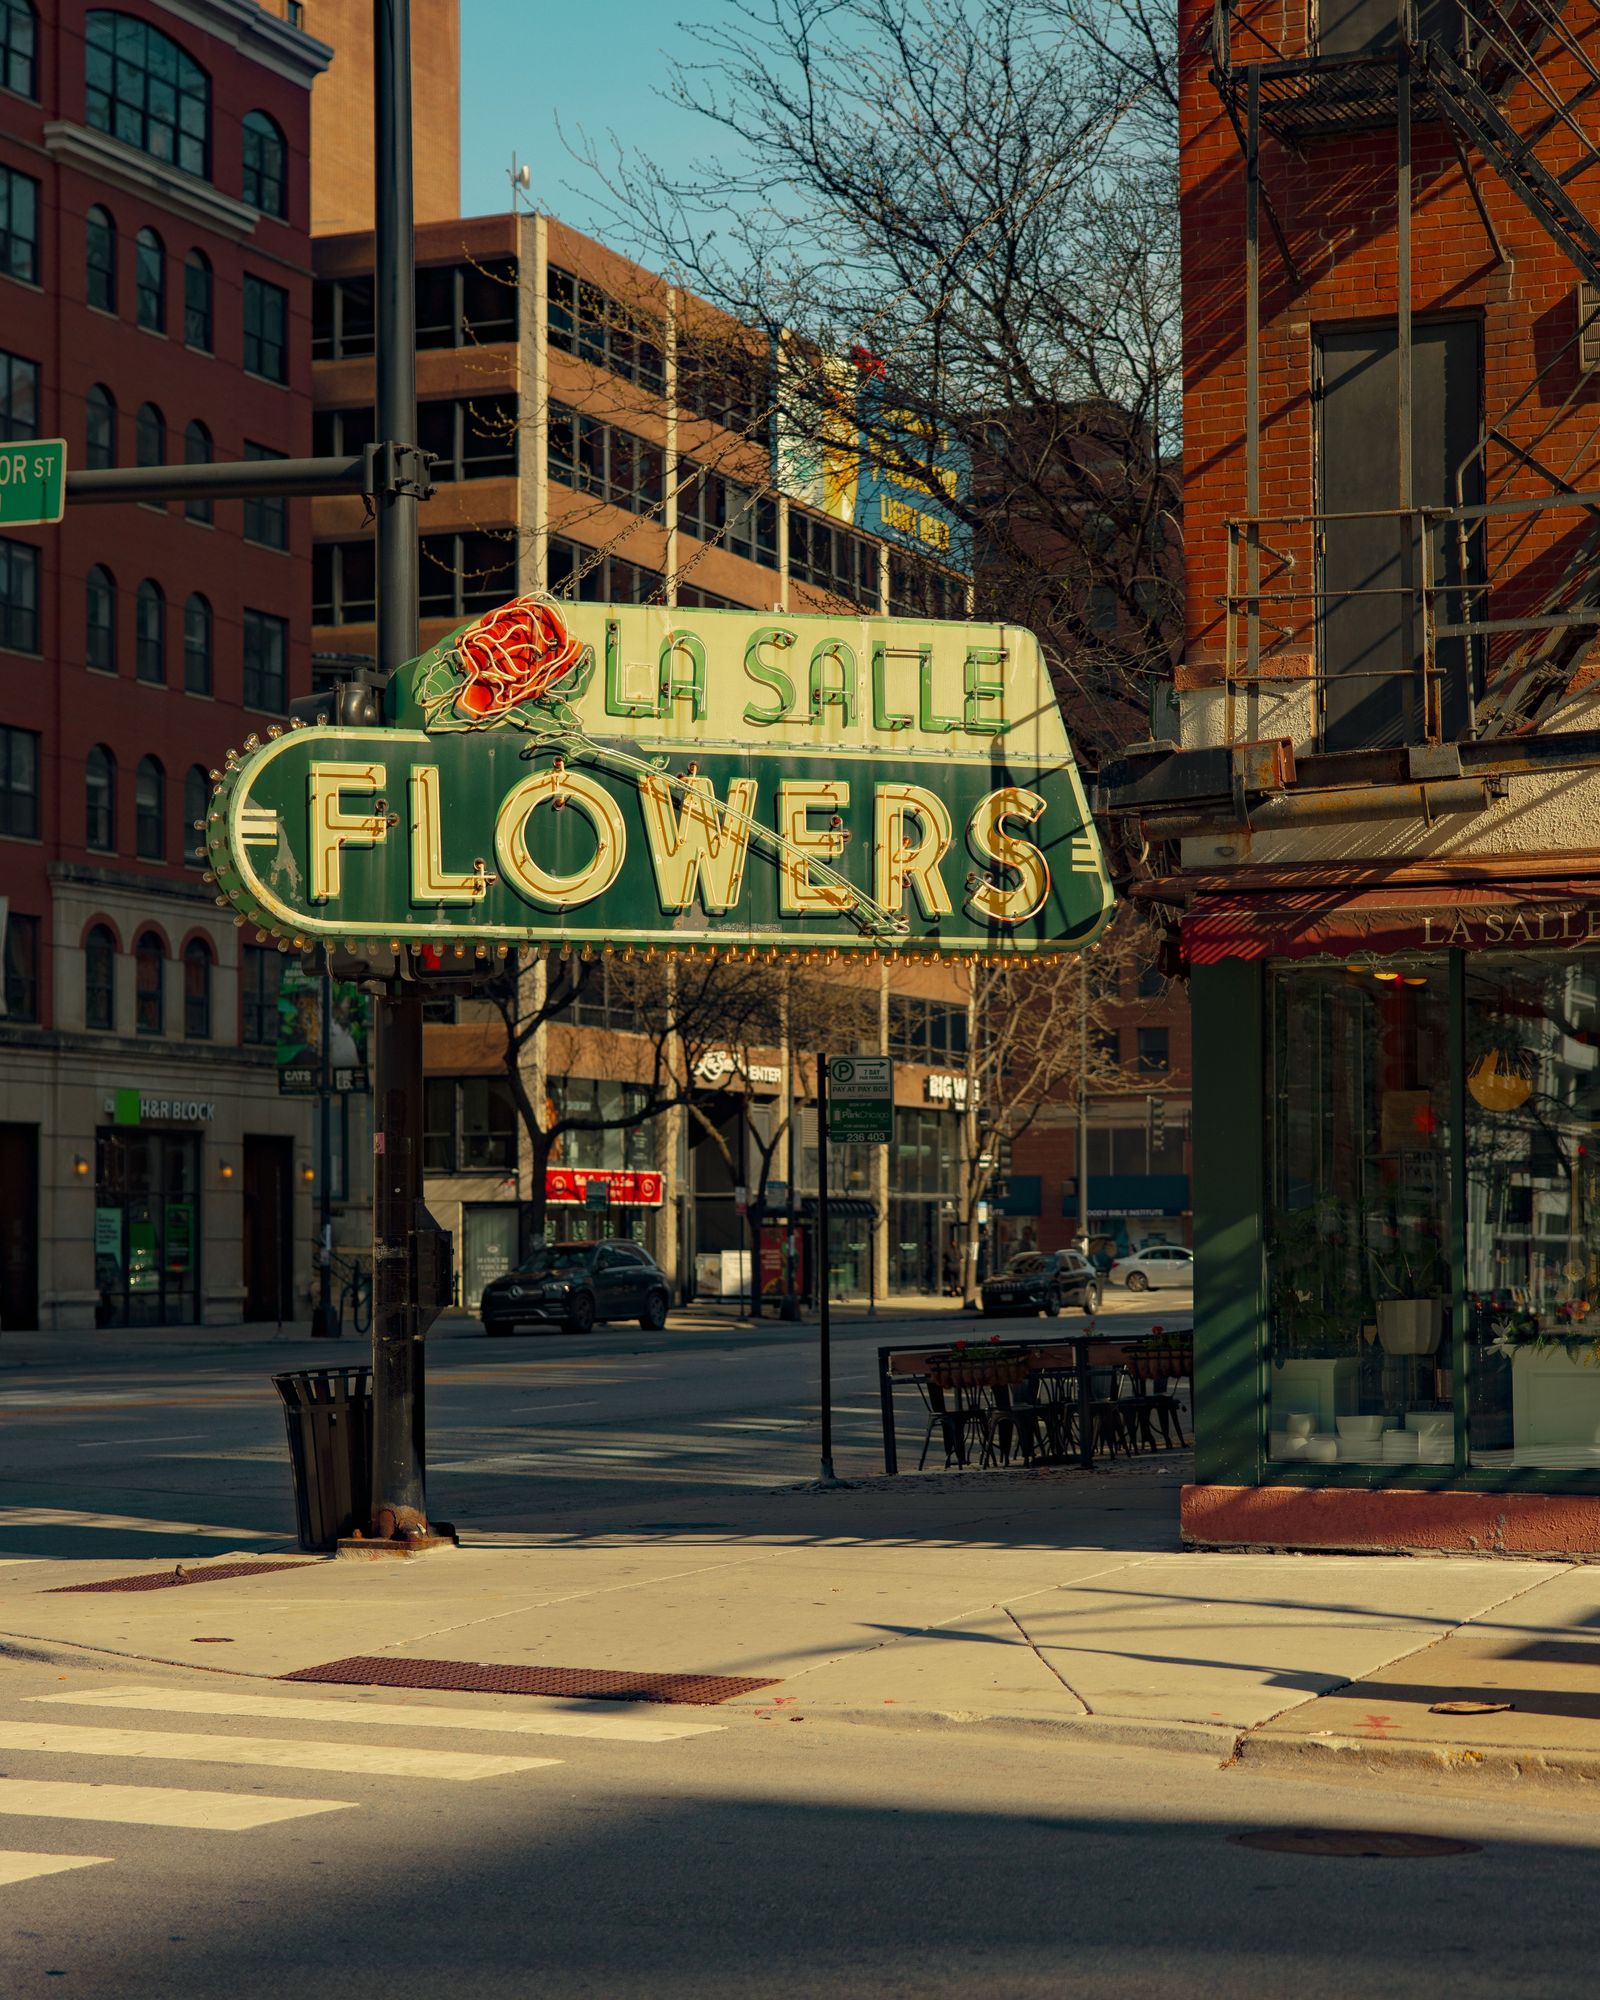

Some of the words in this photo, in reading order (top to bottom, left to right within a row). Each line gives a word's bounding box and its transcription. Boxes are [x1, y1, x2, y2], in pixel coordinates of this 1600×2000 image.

[33, 457, 55, 478] ST
[603, 618, 708, 721] LA
[744, 627, 1011, 735] SALLE
[308, 759, 1051, 922] FLOWERS
[1422, 917, 1474, 944] LA
[1485, 911, 1600, 942] SALLE
[284, 1070, 311, 1081] CATS
[929, 1075, 952, 1099] BIG
[953, 1078, 981, 1102] WG
[140, 1098, 169, 1119] H&R
[172, 1101, 215, 1121] BLOCK
[847, 1133, 865, 1141] 236
[867, 1133, 885, 1141] 403
[1129, 1208, 1164, 1216] INSTITUTE
